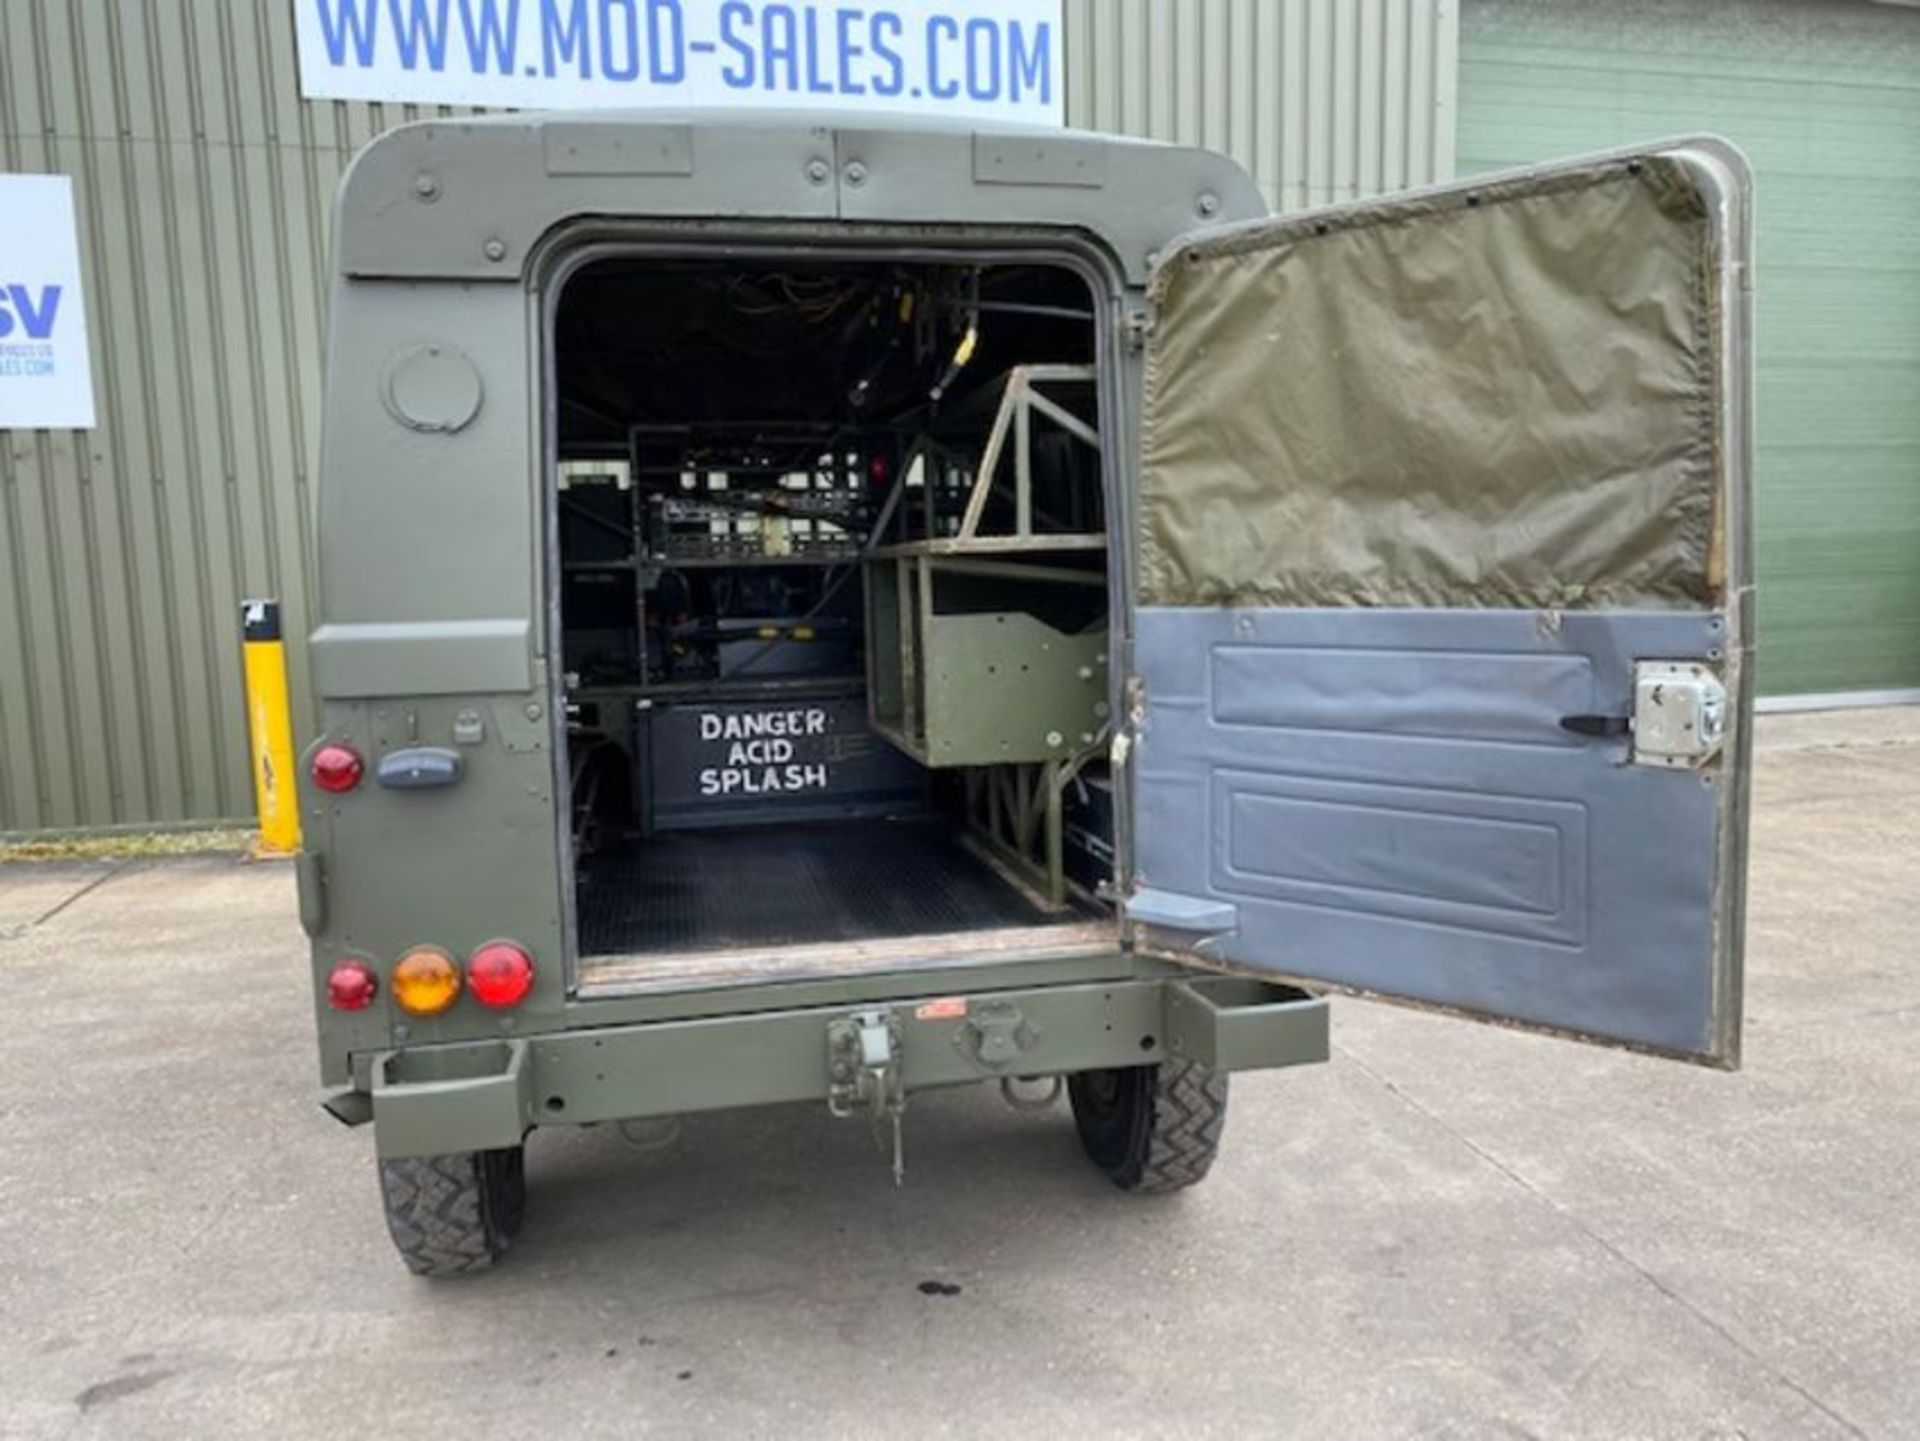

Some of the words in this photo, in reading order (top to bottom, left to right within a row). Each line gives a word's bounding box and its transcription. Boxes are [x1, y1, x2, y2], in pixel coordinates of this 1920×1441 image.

[315, 0, 1052, 104] WWW.MOD-SALES.COM
[701, 709, 825, 740] DANGER
[729, 738, 793, 766] ACID
[700, 764, 826, 795] SPLASH
